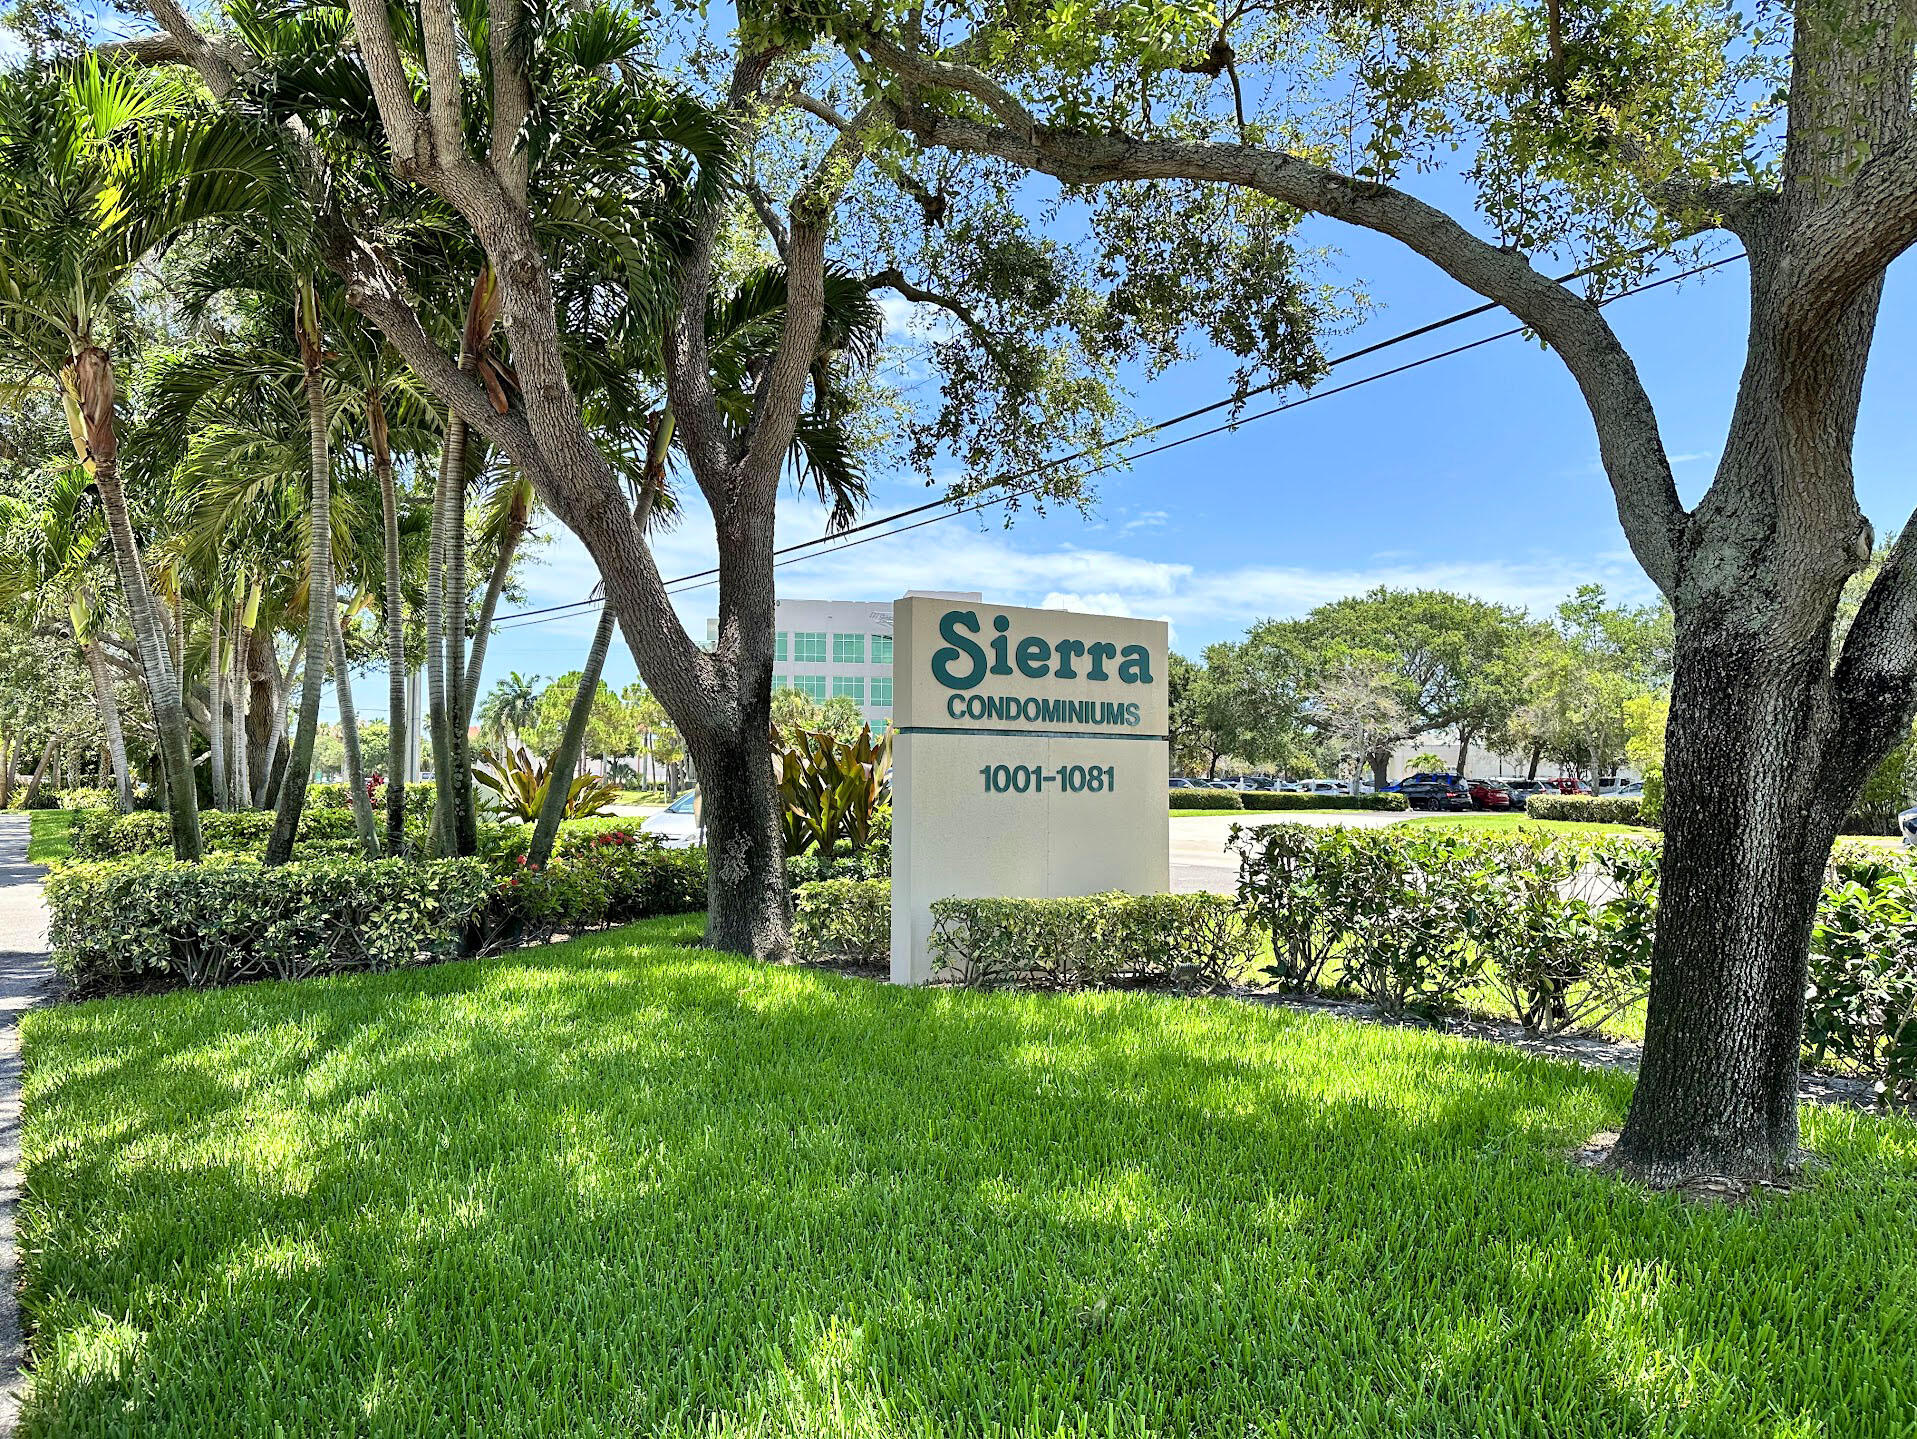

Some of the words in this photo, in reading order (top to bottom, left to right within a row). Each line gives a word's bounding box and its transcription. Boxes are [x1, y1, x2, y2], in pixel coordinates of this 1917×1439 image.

[931, 610, 1153, 690] Sierra
[947, 693, 1140, 726] CONDOMINIUMS
[980, 764, 1115, 793] 1001-1081
